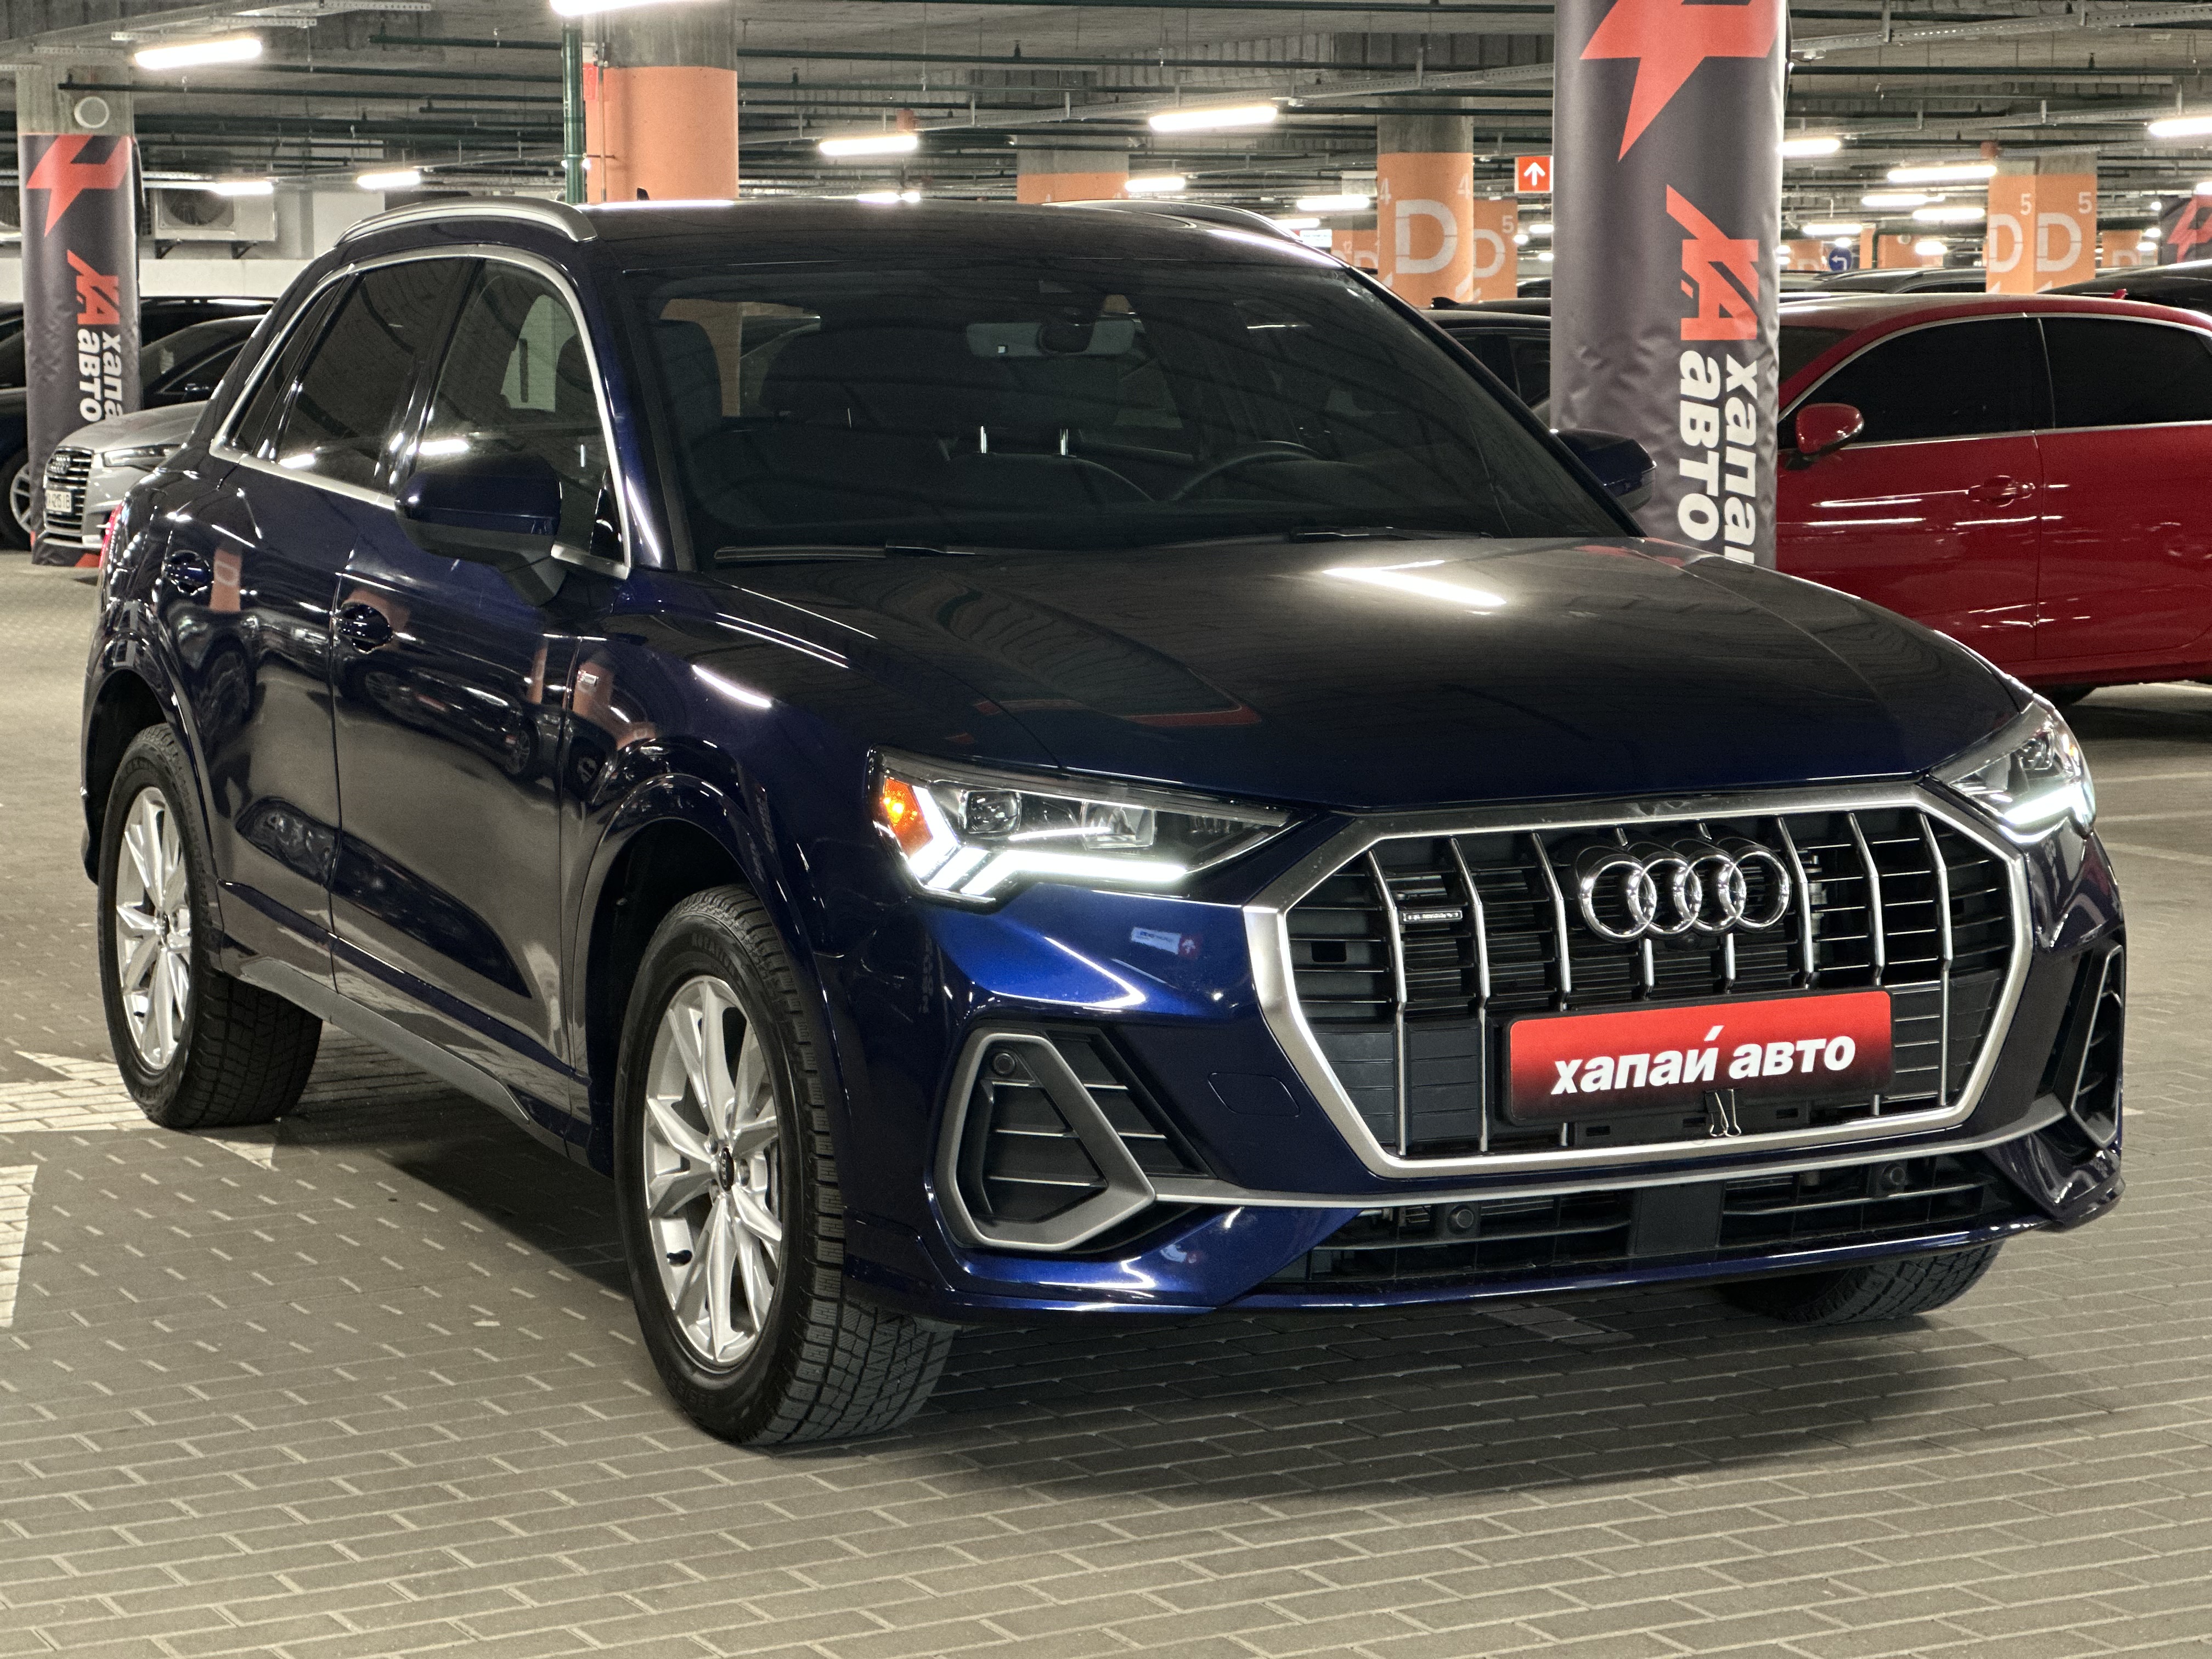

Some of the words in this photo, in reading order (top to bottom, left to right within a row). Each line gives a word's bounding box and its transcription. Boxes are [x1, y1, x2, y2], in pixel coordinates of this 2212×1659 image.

[1379, 177, 1392, 205] 4
[1458, 173, 1471, 199] 4
[2020, 193, 2032, 216] 5
[2078, 191, 2092, 214] 5
[1395, 199, 1458, 274] D
[1502, 215, 1514, 234] 5
[1989, 213, 2023, 273] D
[2036, 212, 2082, 272] D
[1473, 228, 1505, 278] D
[77, 329, 102, 422] авто
[1678, 350, 1720, 541] авто
[1729, 1035, 1857, 1080] авто
